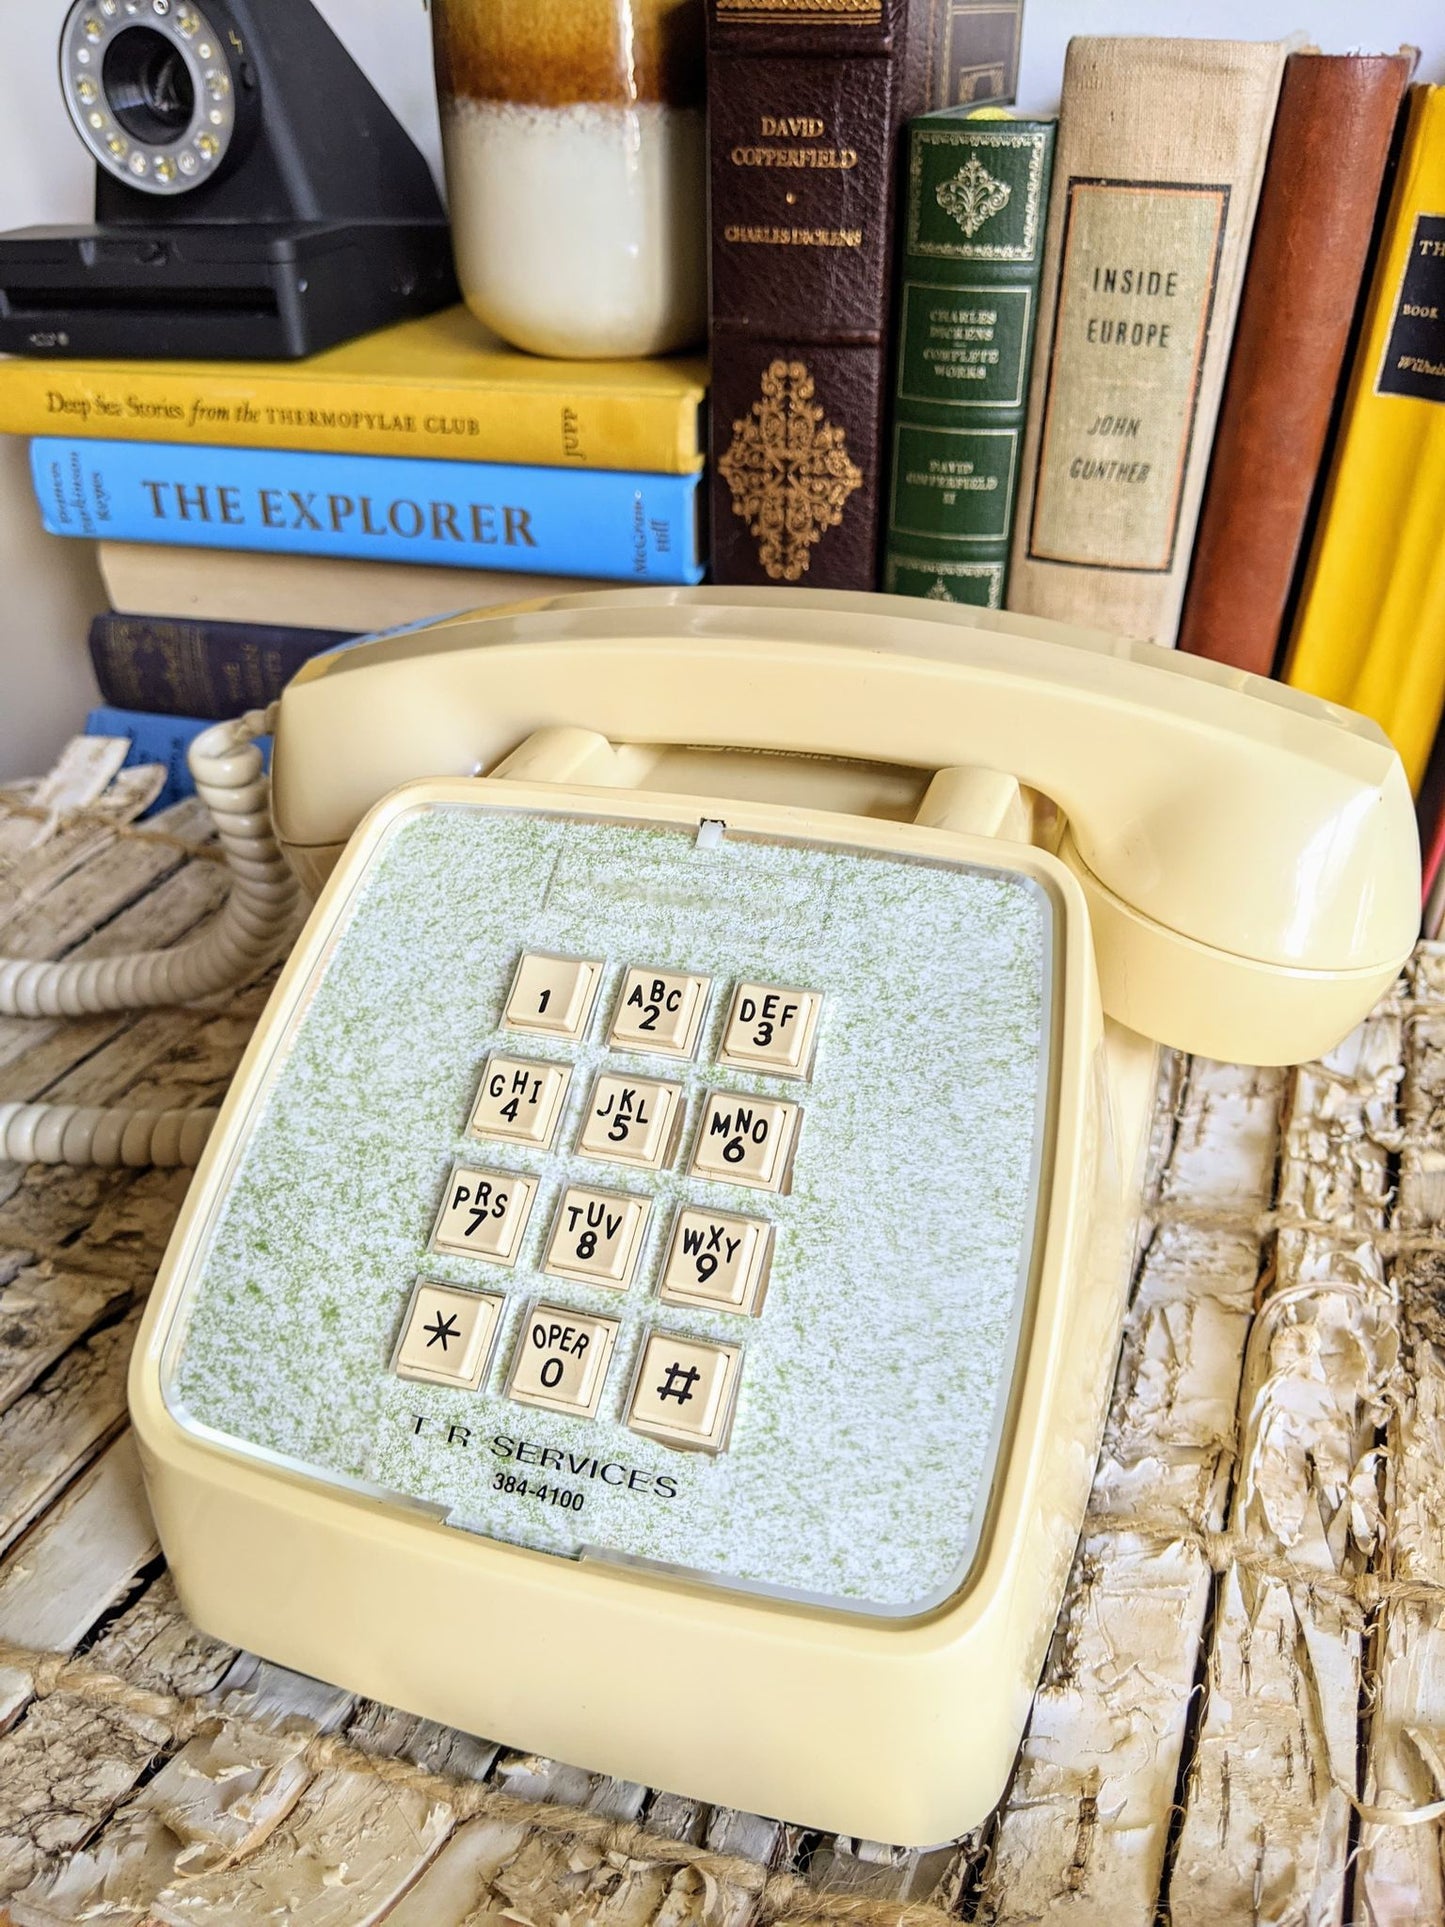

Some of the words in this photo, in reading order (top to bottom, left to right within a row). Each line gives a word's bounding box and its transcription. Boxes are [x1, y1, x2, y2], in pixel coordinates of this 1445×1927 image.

[761, 116, 824, 137] DAVID
[731, 147, 858, 169] COPPERFIELD
[1092, 267, 1178, 297] INSIDE
[929, 309, 997, 325] CHARLES
[1402, 303, 1439, 319] BOOK
[929, 326, 993, 341] DICKENS
[1087, 319, 1170, 348] EUROPE
[923, 348, 999, 364] COMPLETE
[934, 365, 986, 379] WORKS
[46, 391, 90, 421] Deep
[94, 395, 123, 416] Sea
[128, 395, 184, 418] Stories
[188, 399, 229, 427] from
[234, 400, 259, 424] the
[266, 407, 416, 432] THERMOPYLAE
[424, 416, 480, 435] CLUB
[1088, 415, 1142, 437] JOHN
[561, 407, 586, 461] JUPP
[929, 460, 974, 474] DAVID
[1069, 457, 1151, 484] GUNTHER
[140, 479, 244, 525] THE
[258, 489, 538, 547] EXPLORER
[538, 989, 551, 1013] 1
[627, 979, 682, 1012] ABC
[639, 1005, 660, 1031] 2
[739, 994, 798, 1026] DEF
[753, 1021, 773, 1046] 3
[489, 1070, 542, 1103] GHI
[500, 1098, 518, 1122] 4
[597, 1088, 648, 1123] JKL
[608, 1114, 629, 1141] 5
[710, 1108, 768, 1144] MNO
[722, 1136, 745, 1163] 6
[452, 1181, 507, 1218] PRS
[464, 1208, 488, 1236] 7
[568, 1201, 622, 1240] TUV
[576, 1231, 598, 1259] 8
[682, 1225, 741, 1263] WXY
[695, 1254, 718, 1283] 9
[533, 1324, 589, 1359] OPER
[412, 1414, 430, 1434] T
[448, 1426, 471, 1447] R
[490, 1436, 677, 1499] SERVICES
[493, 1473, 584, 1511] 384-4100
